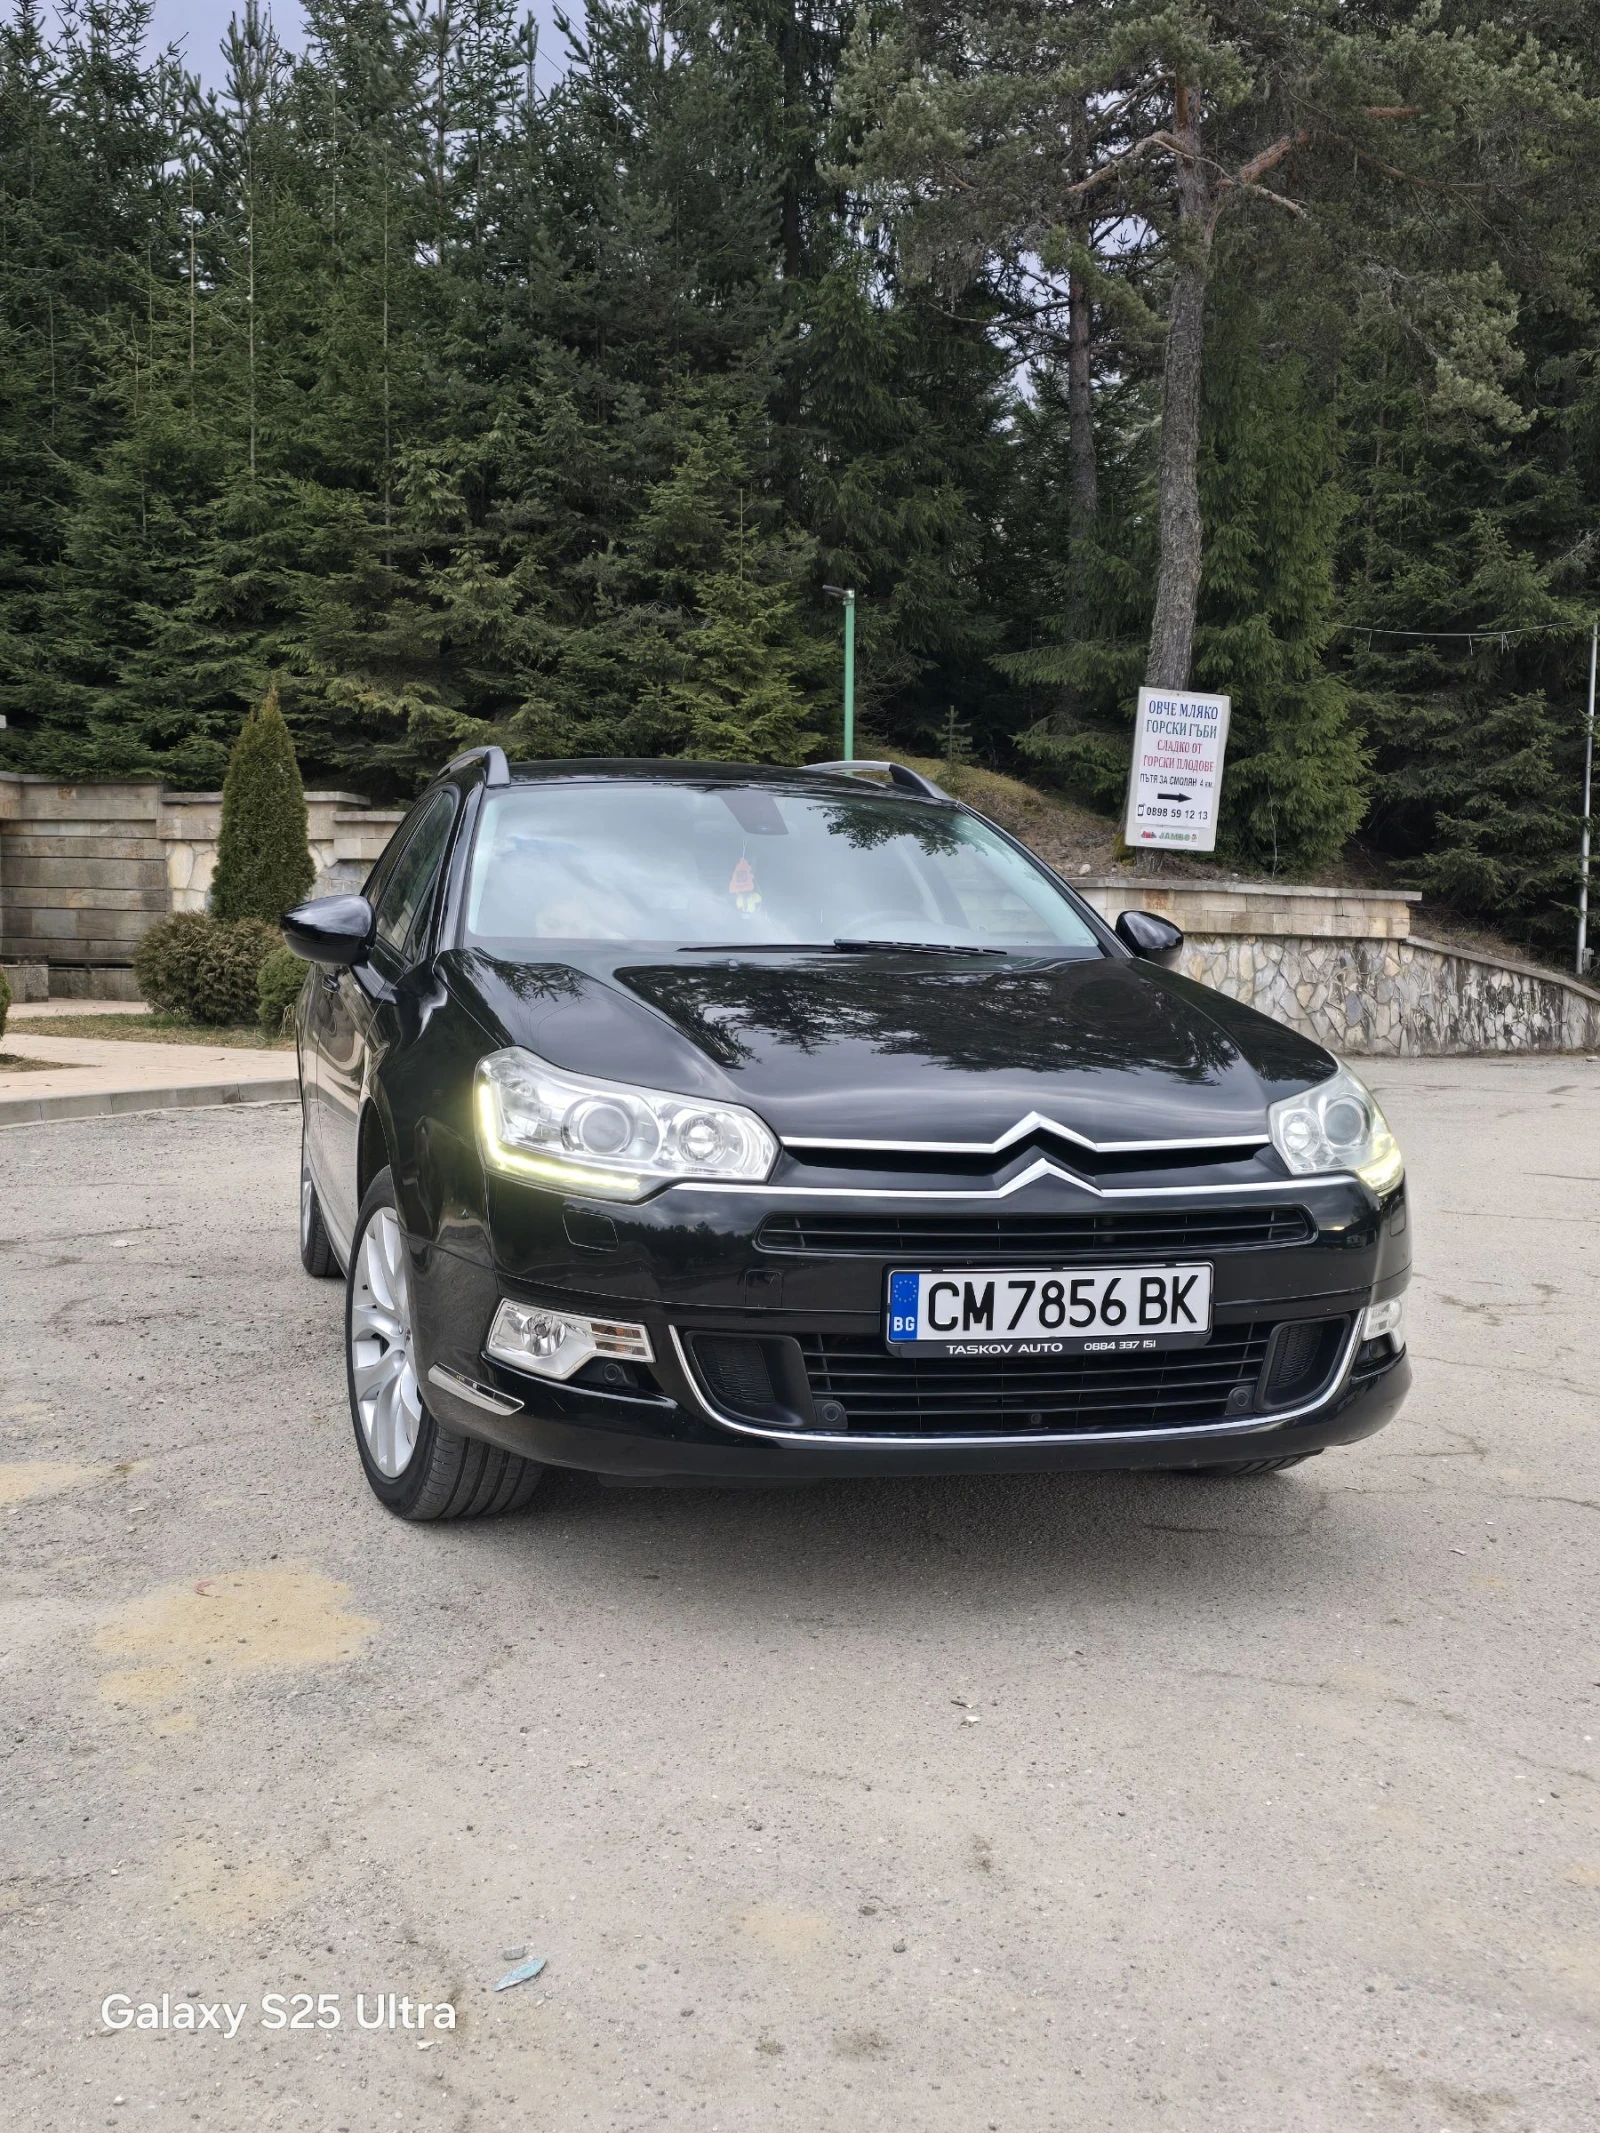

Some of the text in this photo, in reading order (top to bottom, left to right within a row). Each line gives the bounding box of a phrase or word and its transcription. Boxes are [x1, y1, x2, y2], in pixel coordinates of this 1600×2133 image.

[1148, 700, 1219, 720] ОВЧЕ МЛЯКО
[1146, 719, 1218, 739] ГОРСКИ ГЪБИ
[1157, 739, 1203, 755] СЛАДКО ОТ
[1143, 754, 1215, 773] ГОРСКИ ПЛОДОВЕ
[1140, 773, 1158, 783] ПЪТЯ
[1159, 775, 1168, 784] ЗА
[1169, 776, 1198, 787] СМОЛЯН
[1199, 779, 1204, 788] 4
[1146, 807, 1208, 820] 0898 59 12 13
[893, 1274, 1199, 1332] BG CM 7856 BK
[946, 1345, 1014, 1355] TASKOV
[1018, 1342, 1063, 1353] AUTO
[1083, 1341, 1116, 1351] 0884
[1119, 1340, 1140, 1350] 337
